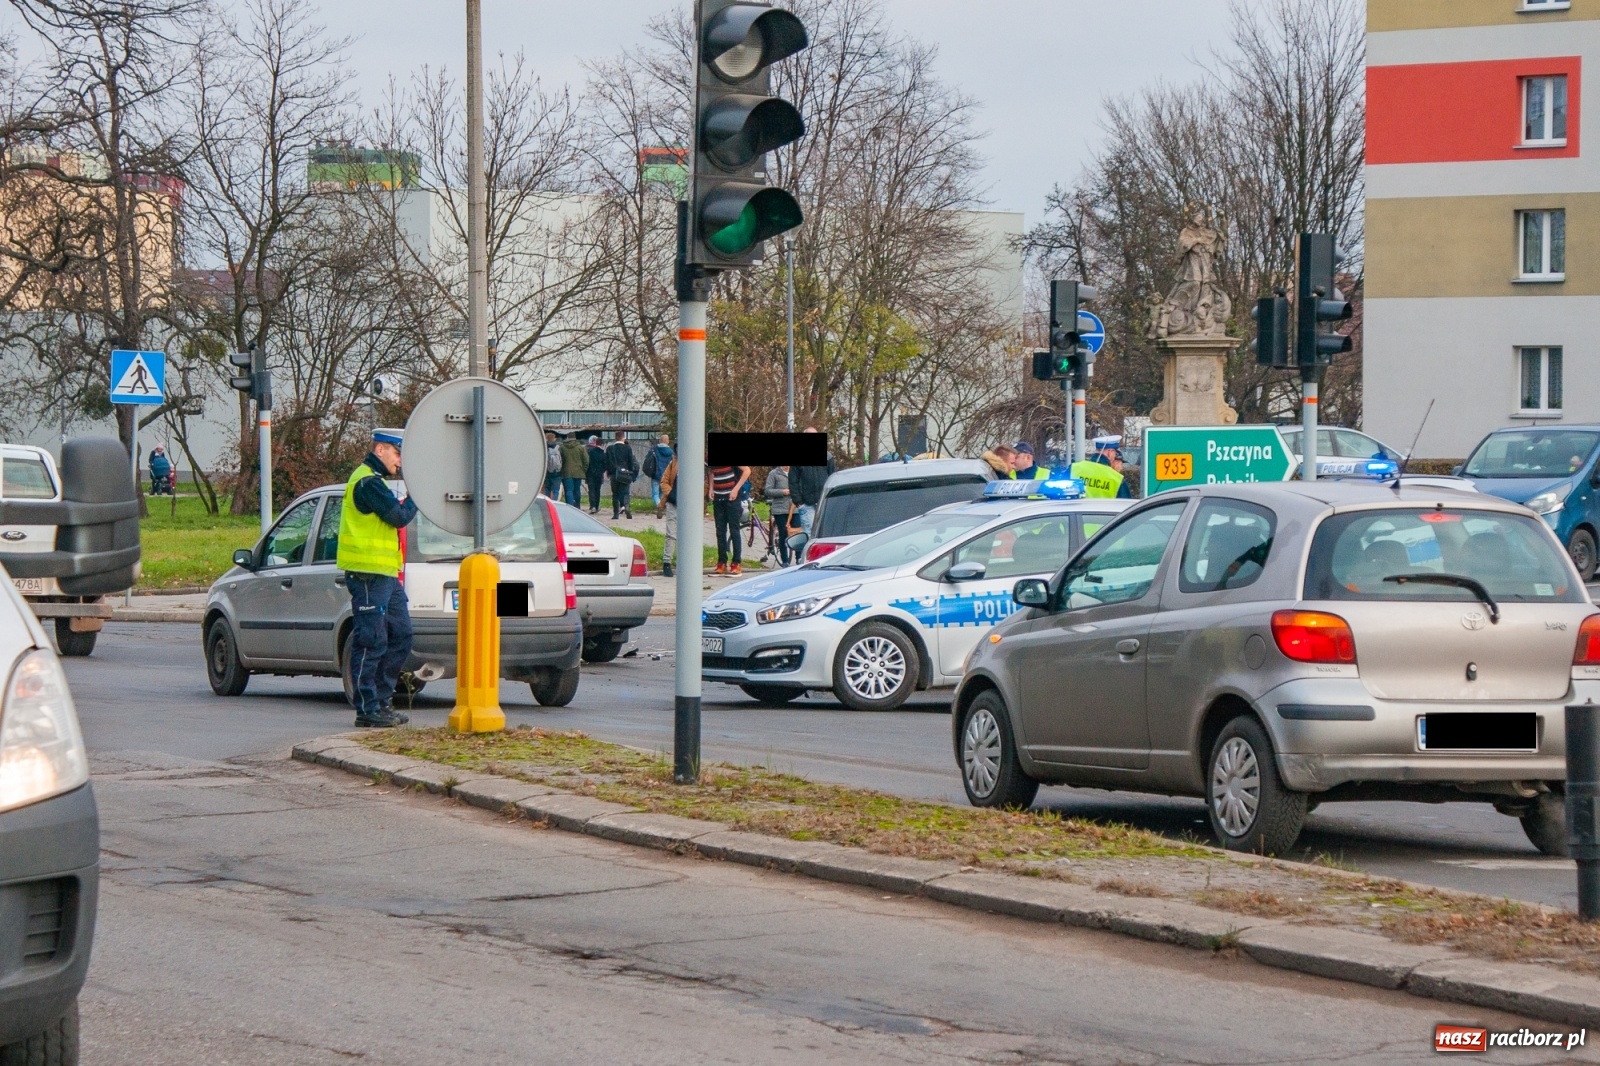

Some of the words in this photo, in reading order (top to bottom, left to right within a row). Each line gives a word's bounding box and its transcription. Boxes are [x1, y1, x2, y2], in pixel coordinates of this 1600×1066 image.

[1206, 439, 1273, 467] Pszczyna
[1163, 457, 1187, 475] 935
[1322, 464, 1353, 474] POLICJA
